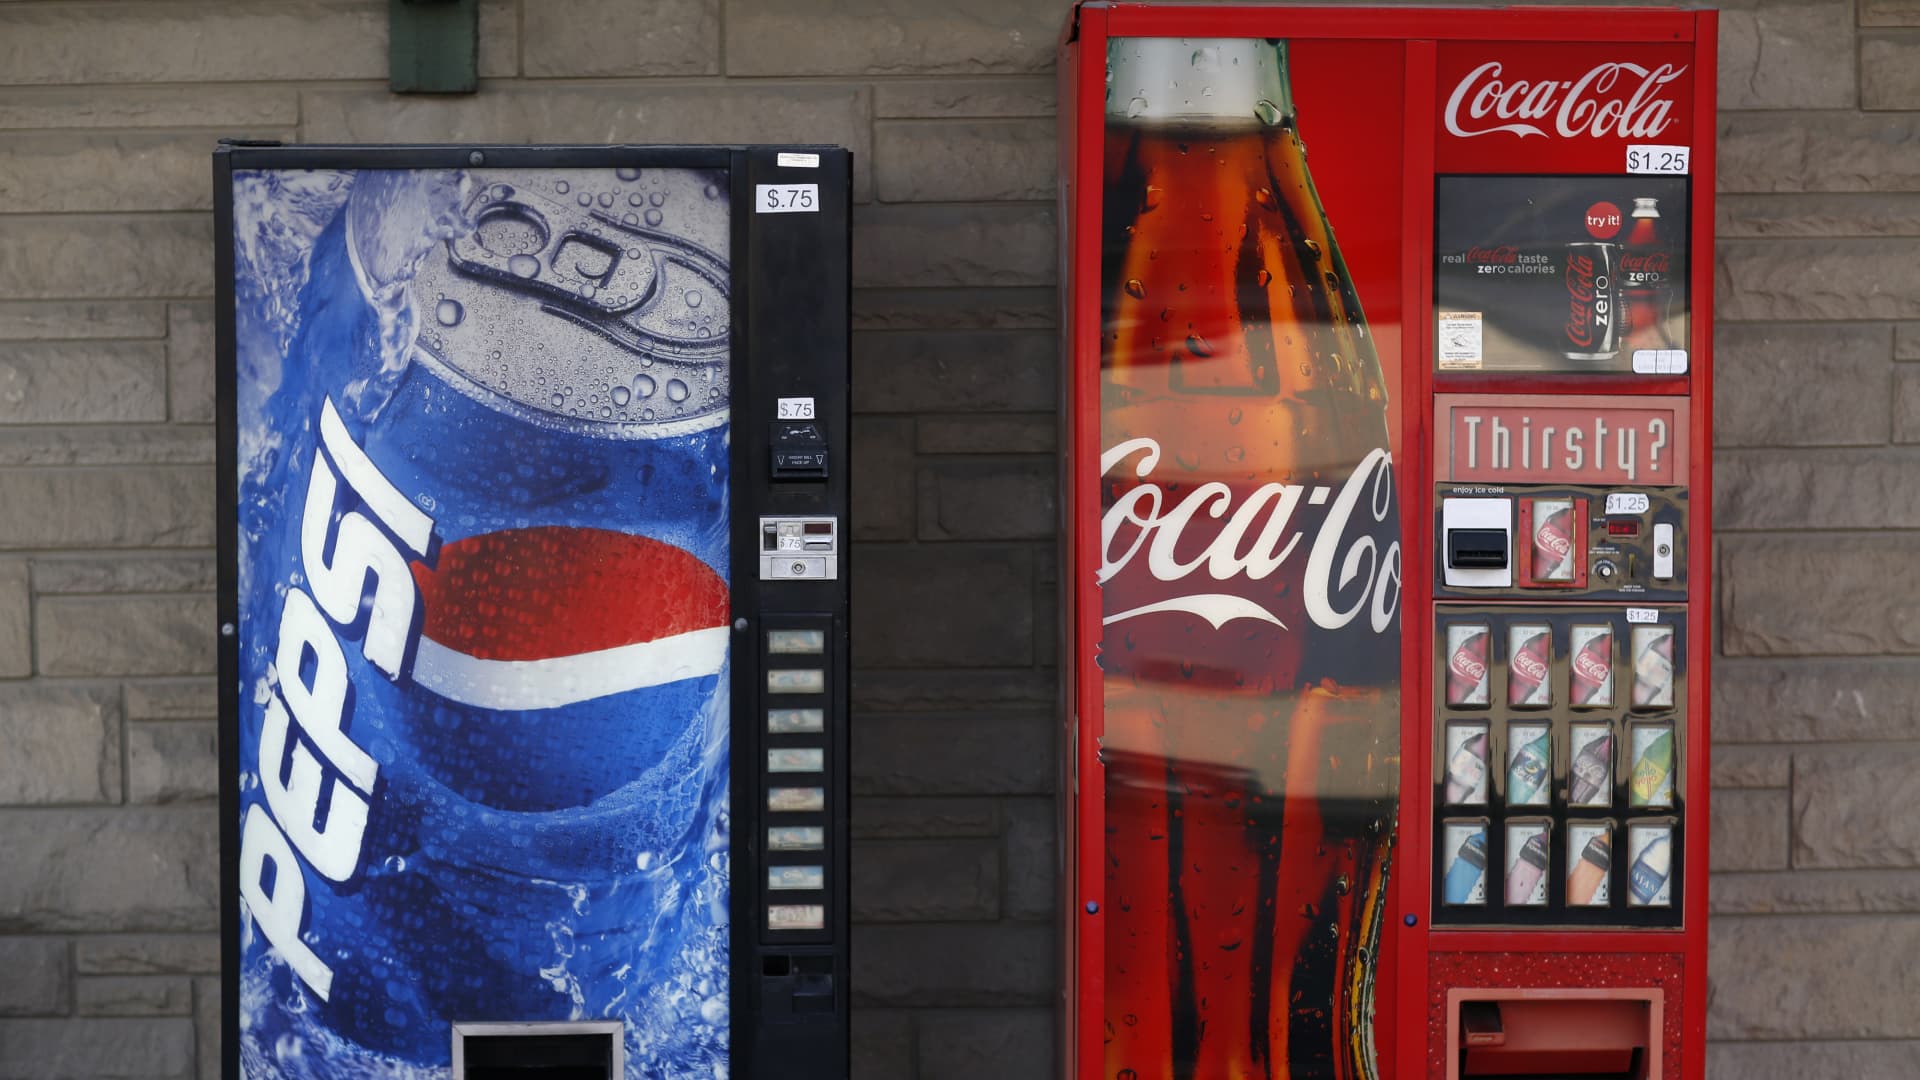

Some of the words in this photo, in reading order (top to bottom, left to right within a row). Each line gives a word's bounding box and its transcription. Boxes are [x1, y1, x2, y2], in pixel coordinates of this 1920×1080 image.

[1444, 61, 1688, 138] Coca-Cola
[1628, 150, 1685, 172] $1.25
[767, 188, 812, 208] $.75
[1587, 215, 1606, 227] try
[1607, 214, 1620, 226] it!
[1442, 252, 1465, 264] real
[1518, 253, 1549, 264] taste
[1477, 265, 1506, 274] zero
[1507, 263, 1556, 274] calories
[1629, 271, 1660, 282] zero
[1595, 275, 1609, 327] zero
[779, 402, 812, 418] $.75
[1463, 415, 1667, 481] Thirsty?
[1452, 486, 1474, 495] enjoy
[1475, 486, 1487, 494] ice
[1487, 486, 1504, 494] cold
[1607, 494, 1647, 512] $1.25
[239, 394, 435, 1003] PEPSI
